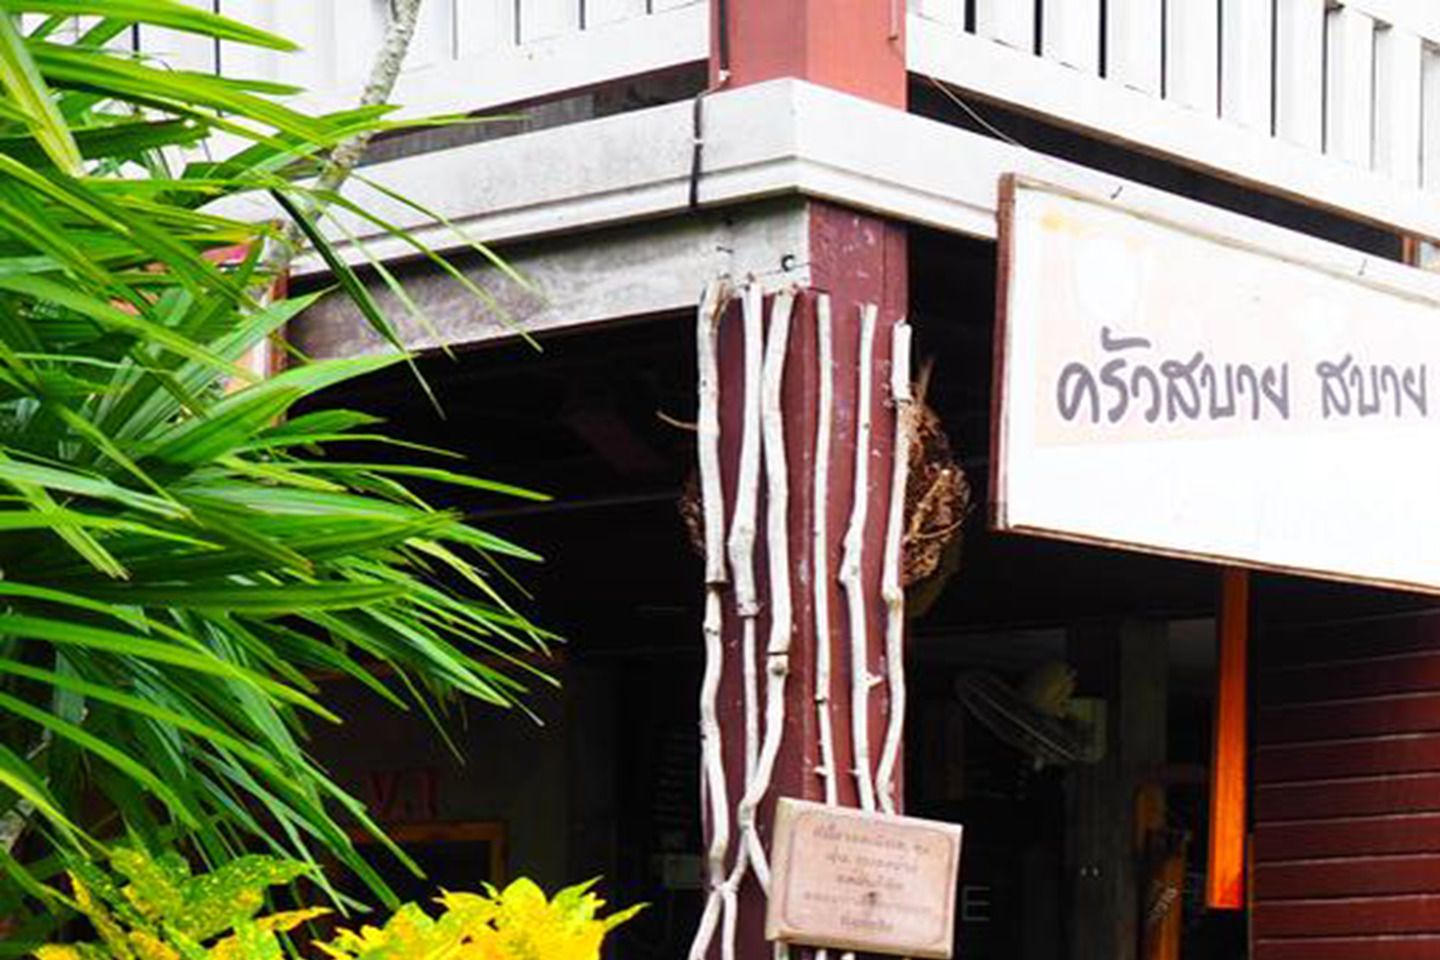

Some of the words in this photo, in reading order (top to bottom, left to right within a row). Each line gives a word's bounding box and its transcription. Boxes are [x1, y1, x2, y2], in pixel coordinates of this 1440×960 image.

[1056, 326, 1291, 424] ครัวสบาย
[1317, 352, 1428, 419] สบาย
